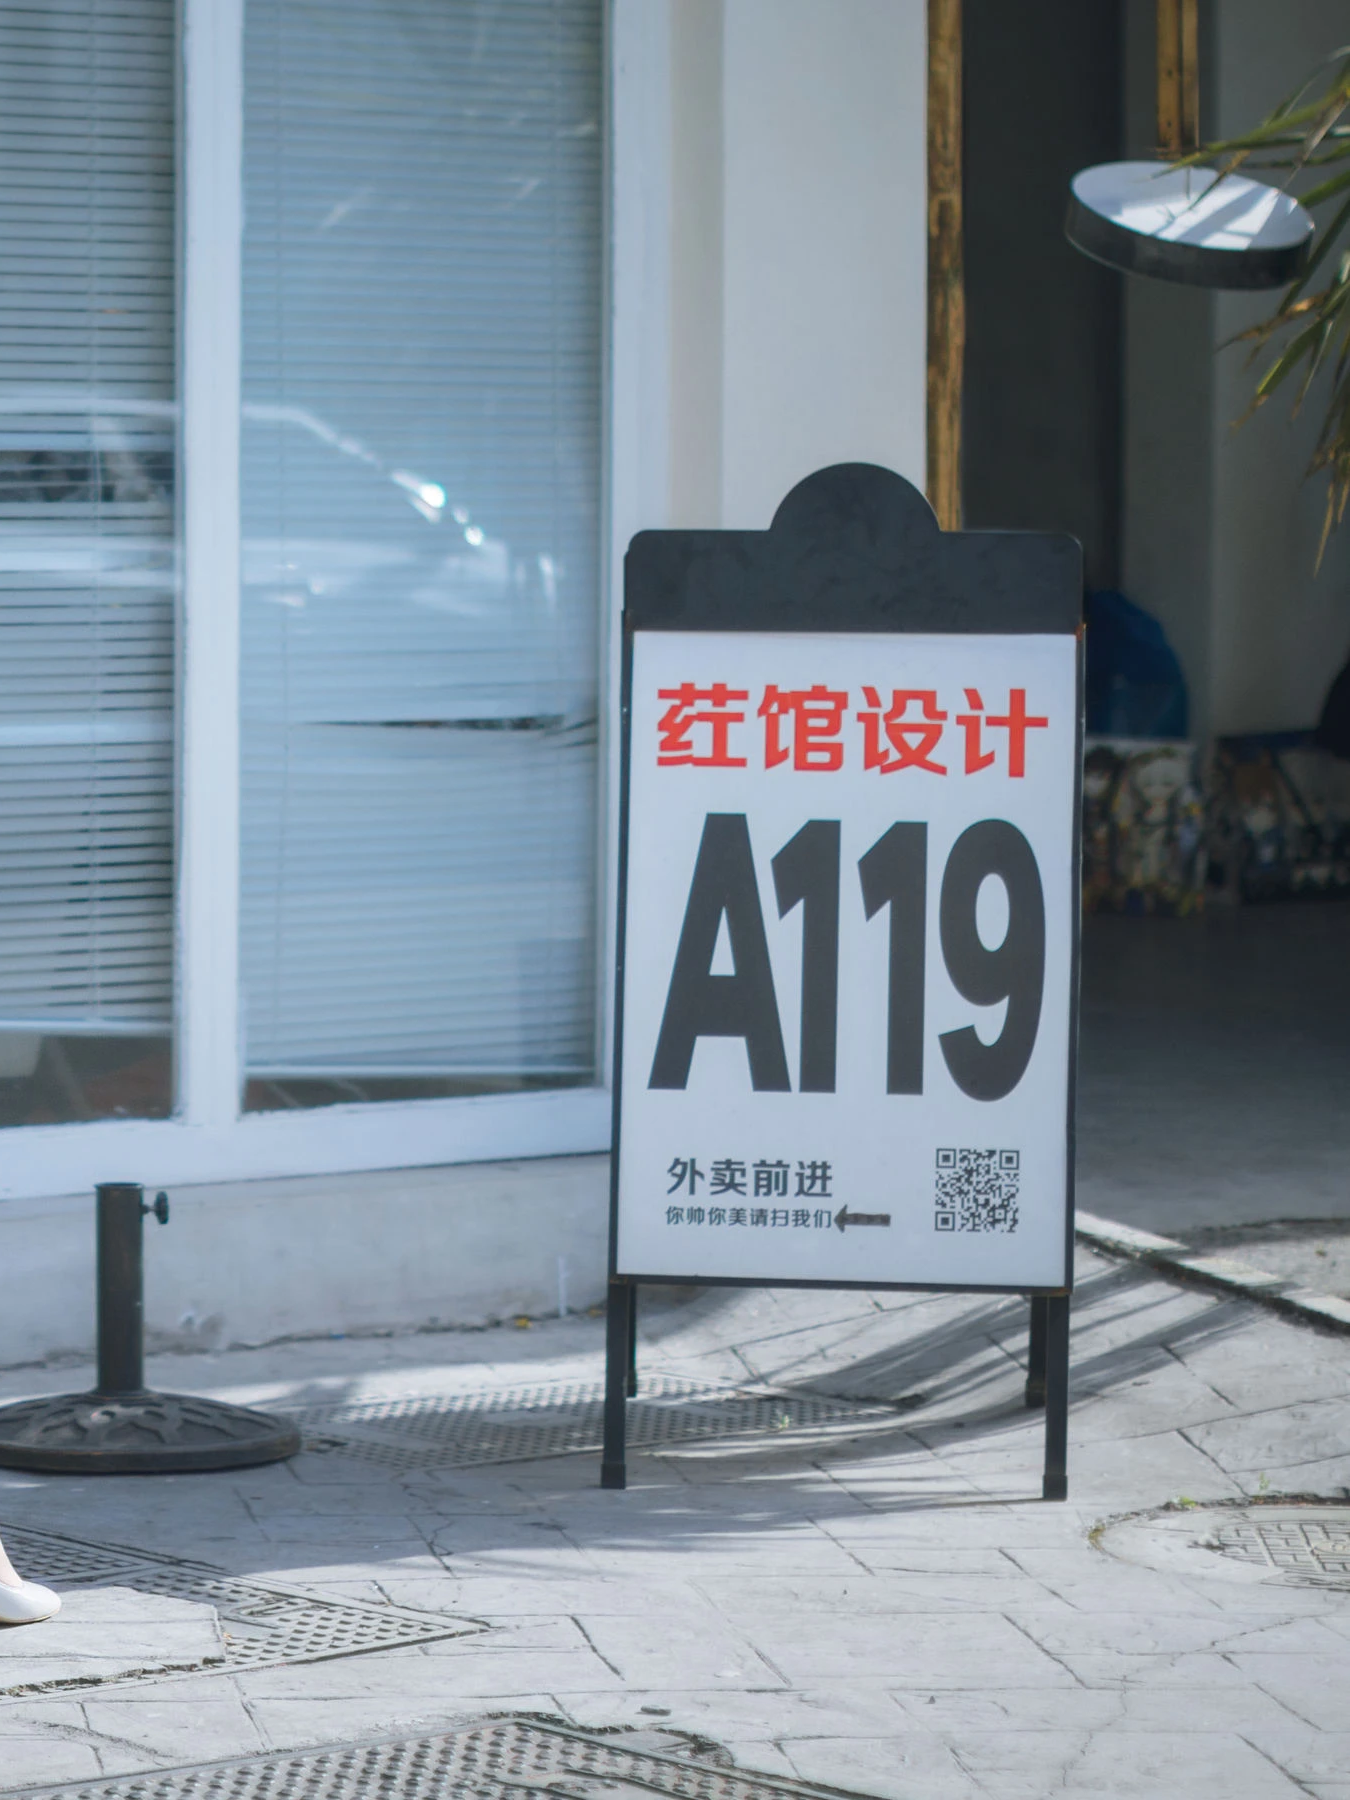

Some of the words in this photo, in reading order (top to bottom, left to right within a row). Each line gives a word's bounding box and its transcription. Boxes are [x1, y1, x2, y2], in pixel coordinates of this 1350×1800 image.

[647, 812, 1046, 1102] A119
[667, 1157, 833, 1198] 外卖前进
[665, 1206, 832, 1229] 你帅你美请扫我们
